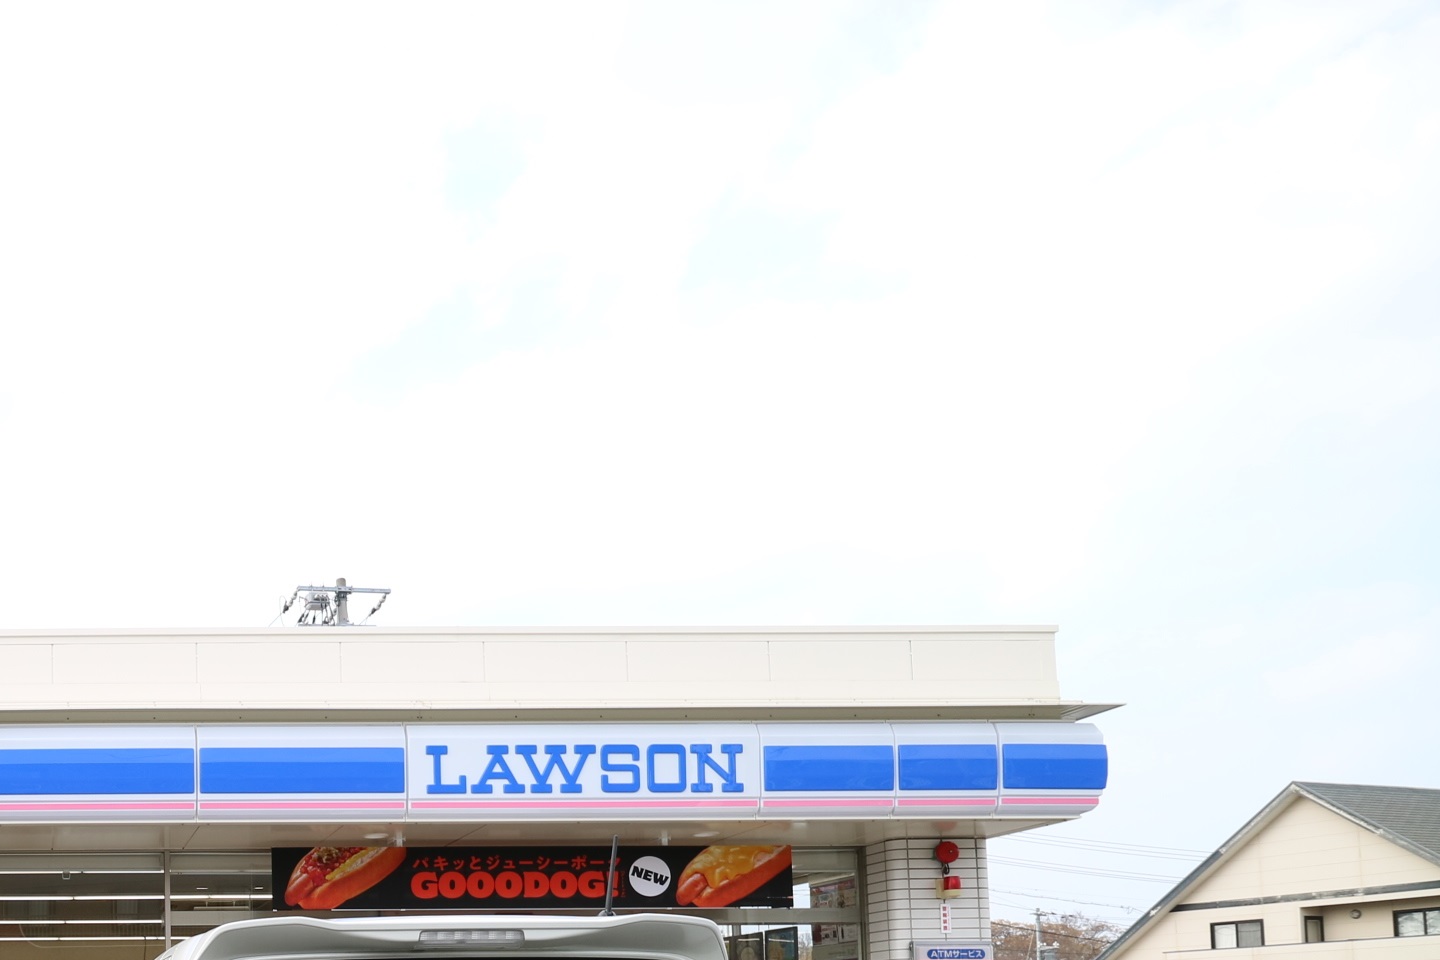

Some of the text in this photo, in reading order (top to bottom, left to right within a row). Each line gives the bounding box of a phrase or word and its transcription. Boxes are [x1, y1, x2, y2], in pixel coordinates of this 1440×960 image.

[426, 744, 744, 794] LAWSON
[630, 865, 669, 886] NEW
[930, 950, 983, 958] ATMサービス
